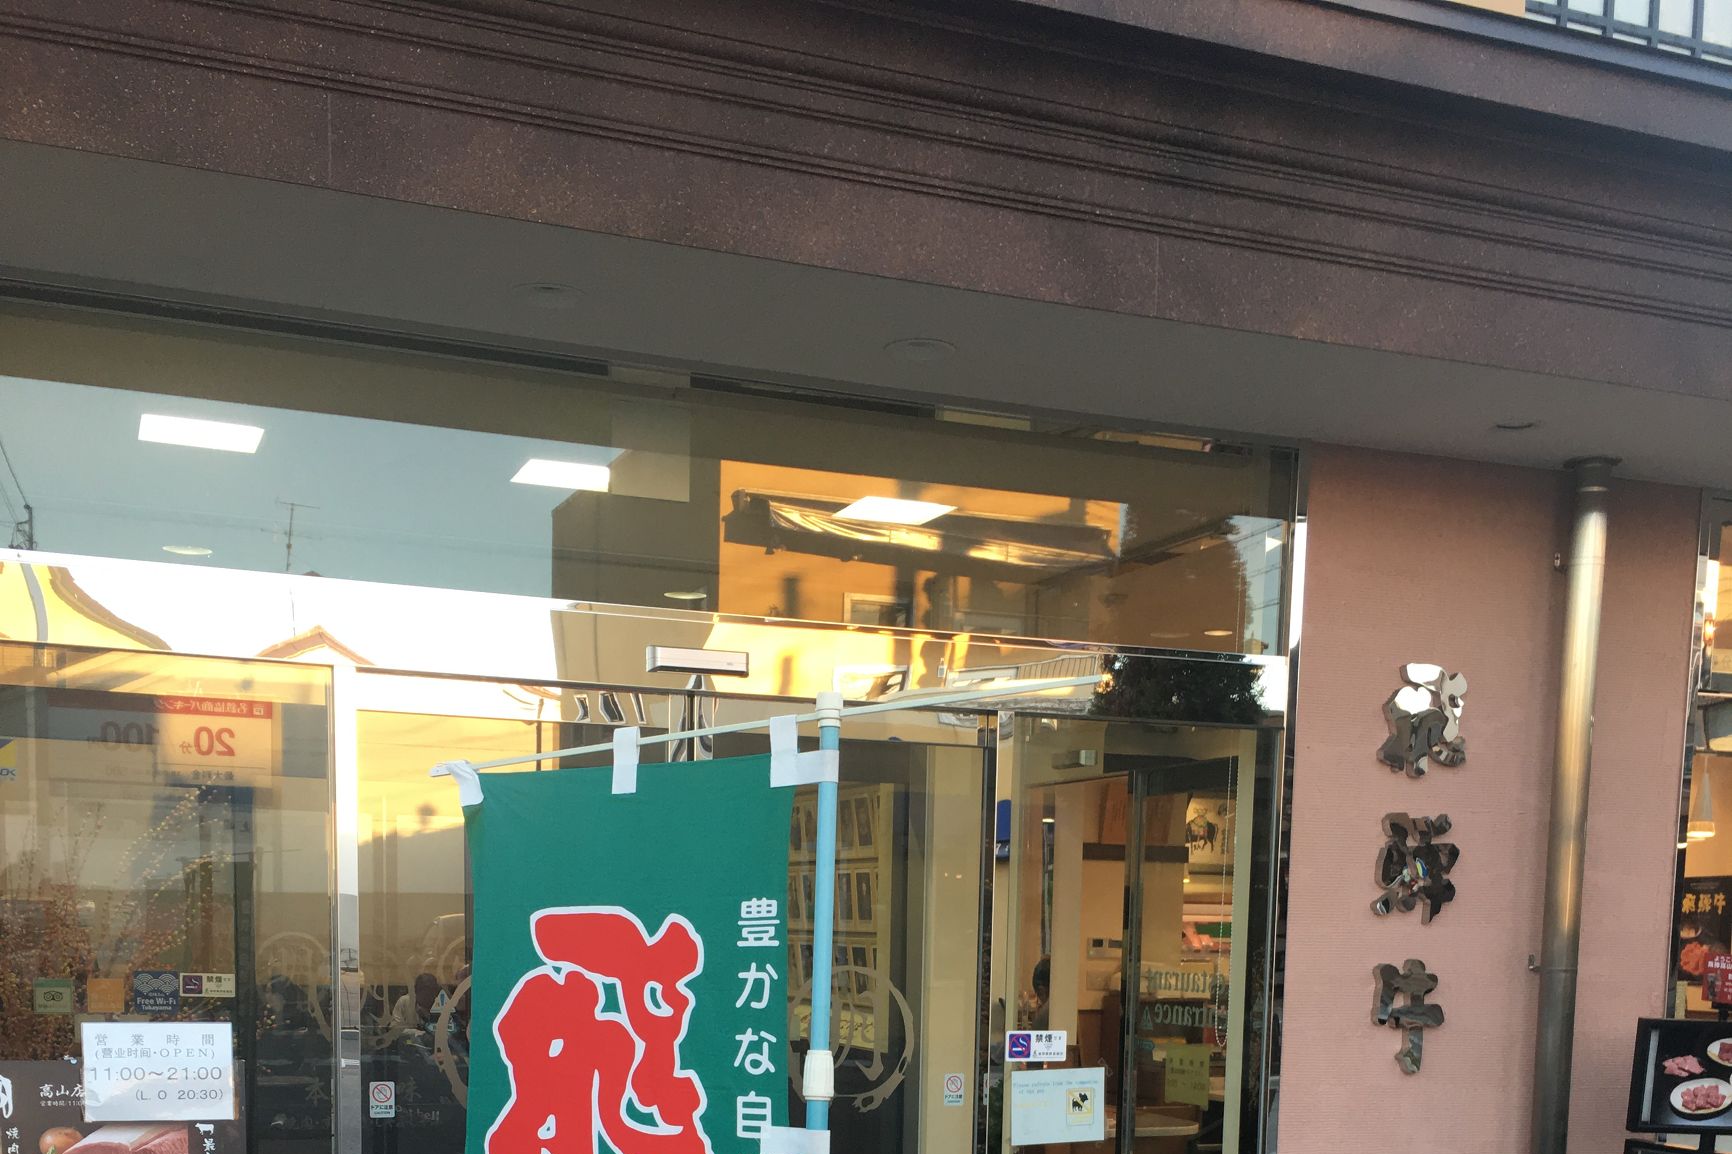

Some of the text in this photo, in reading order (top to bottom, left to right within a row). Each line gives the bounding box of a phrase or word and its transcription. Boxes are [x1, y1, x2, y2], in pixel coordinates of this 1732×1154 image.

[1369, 662, 1469, 1075] 飛騨牛
[1682, 892, 1726, 914] 飛騨牛
[137, 996, 177, 1005] Free Wi-Fi
[94, 1033, 215, 1046] 営業時間
[1035, 1034, 1053, 1043] 禁煙
